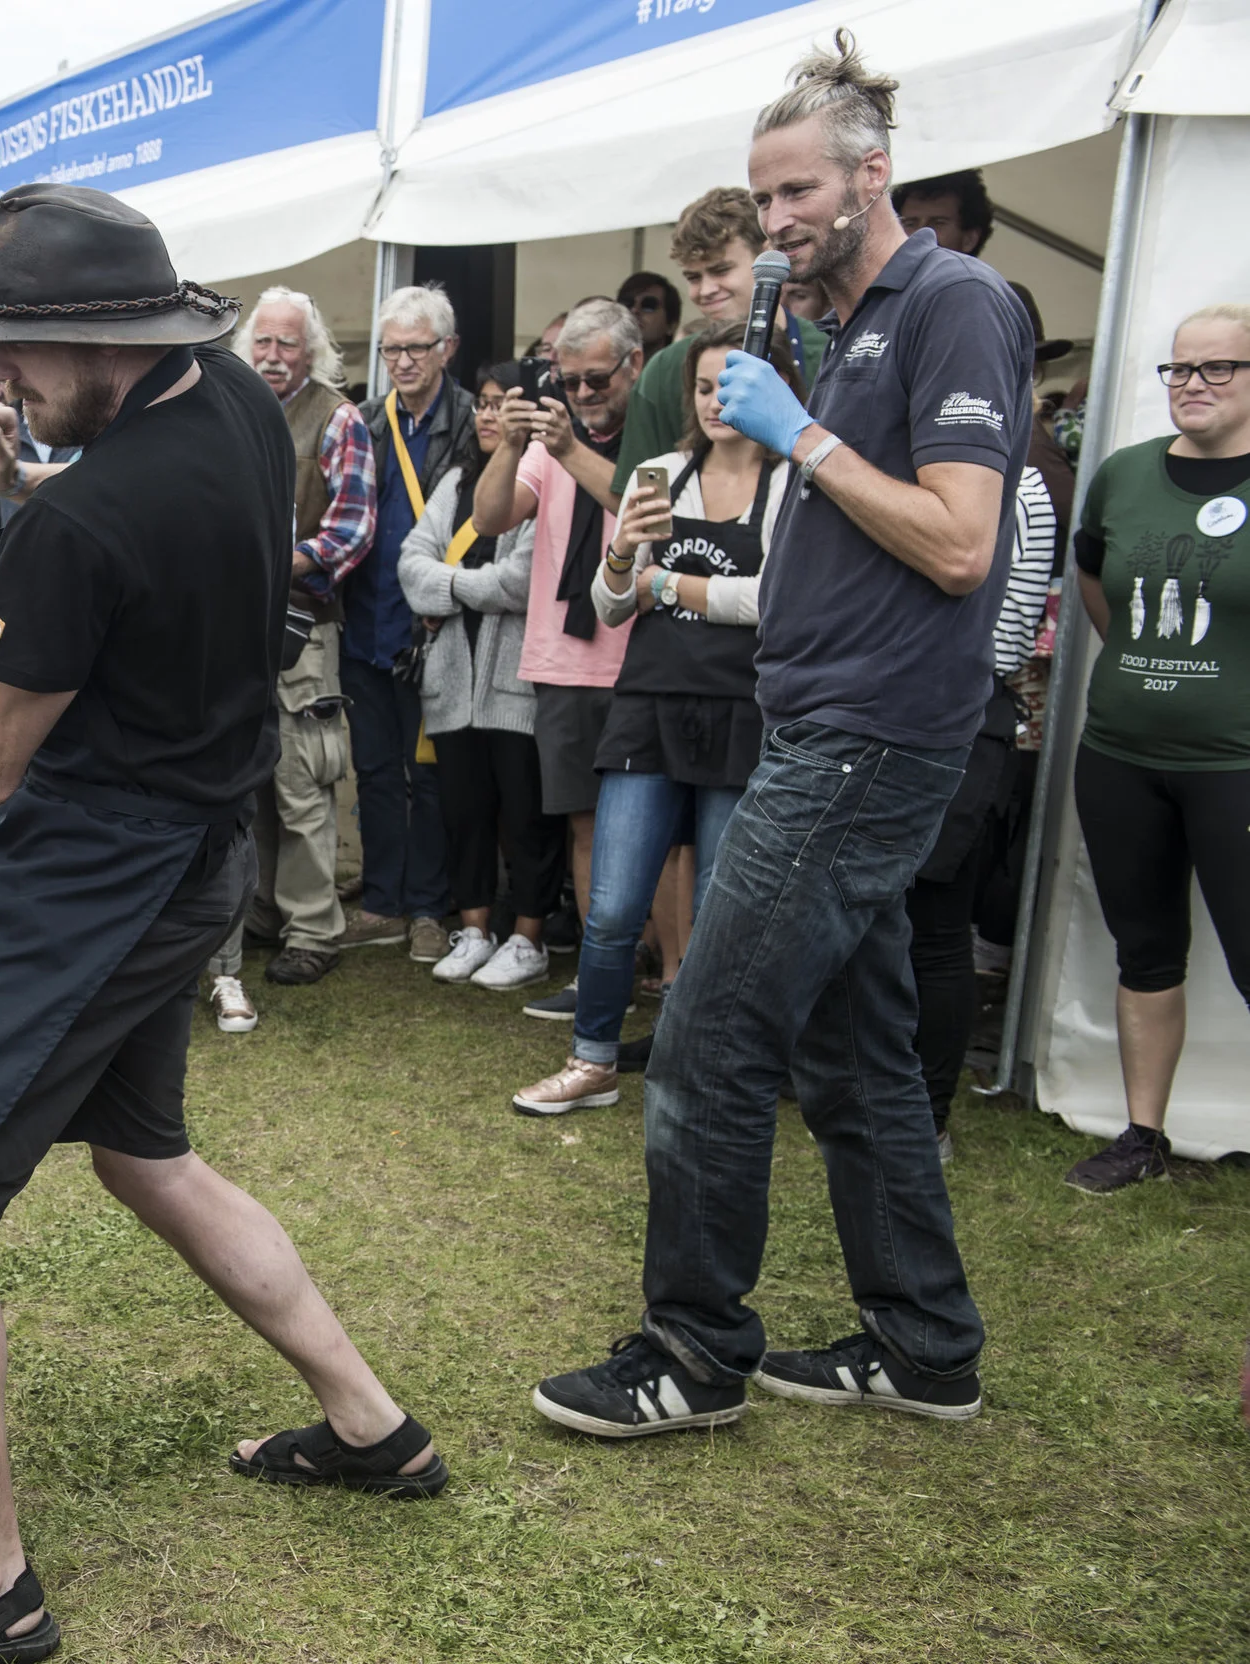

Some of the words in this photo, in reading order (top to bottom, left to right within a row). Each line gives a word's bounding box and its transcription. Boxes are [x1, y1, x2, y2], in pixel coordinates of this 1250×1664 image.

[48, 54, 213, 144] FISKEHANDEL
[107, 152, 134, 173] anno
[940, 406, 992, 417] FISKEHANDEL
[661, 537, 738, 576] NORDISK
[1120, 653, 1148, 668] FOOD
[1150, 658, 1220, 672] FESTIVAL
[1143, 678, 1178, 692] 2017
